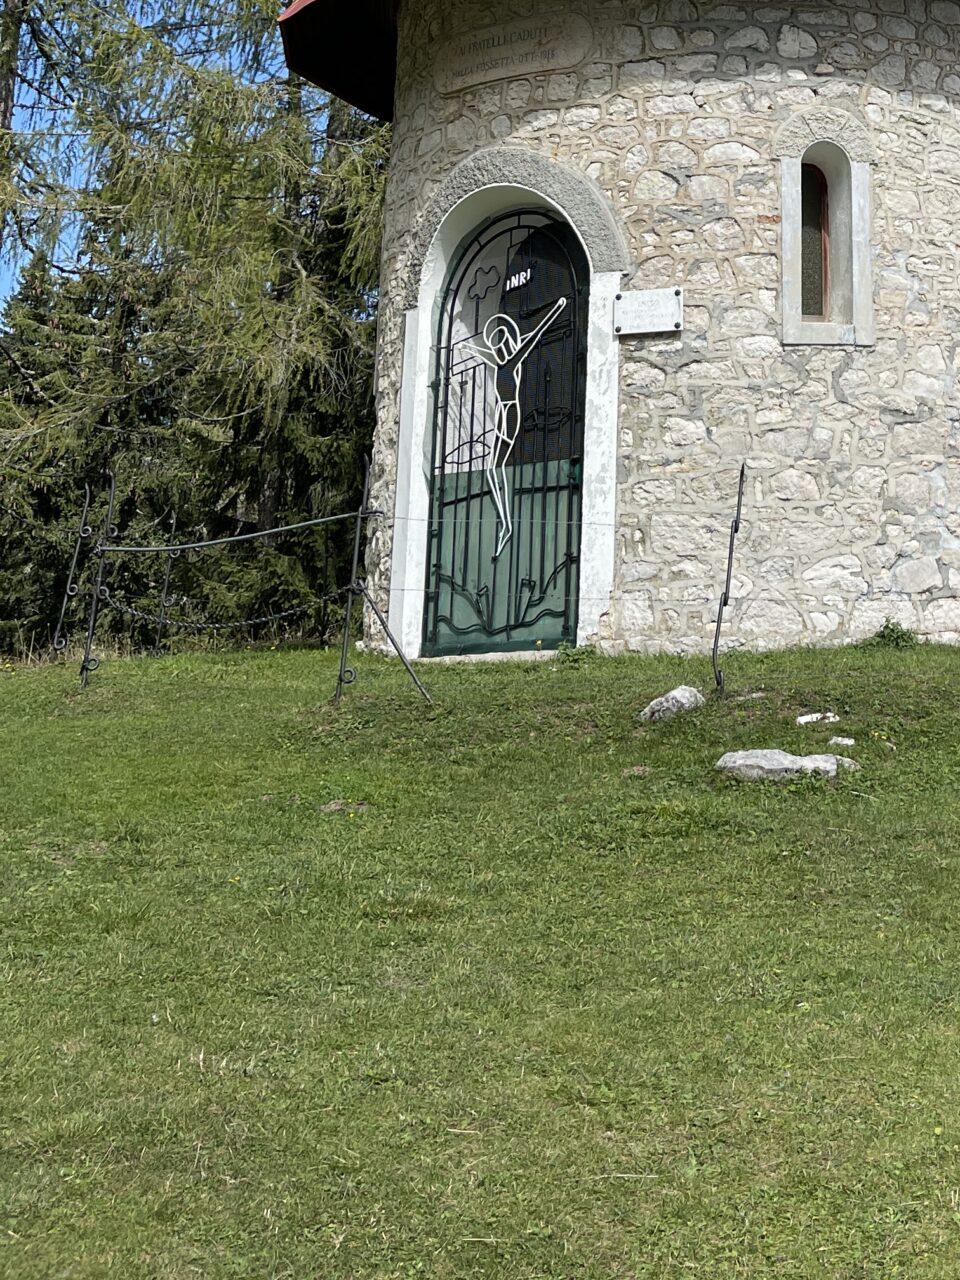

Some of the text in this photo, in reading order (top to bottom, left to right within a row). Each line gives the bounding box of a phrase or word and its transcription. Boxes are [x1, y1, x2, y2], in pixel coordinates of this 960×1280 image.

[468, 35, 506, 54] FRATELLI
[510, 27, 548, 44] CADUTI
[506, 268, 531, 291] INRI
